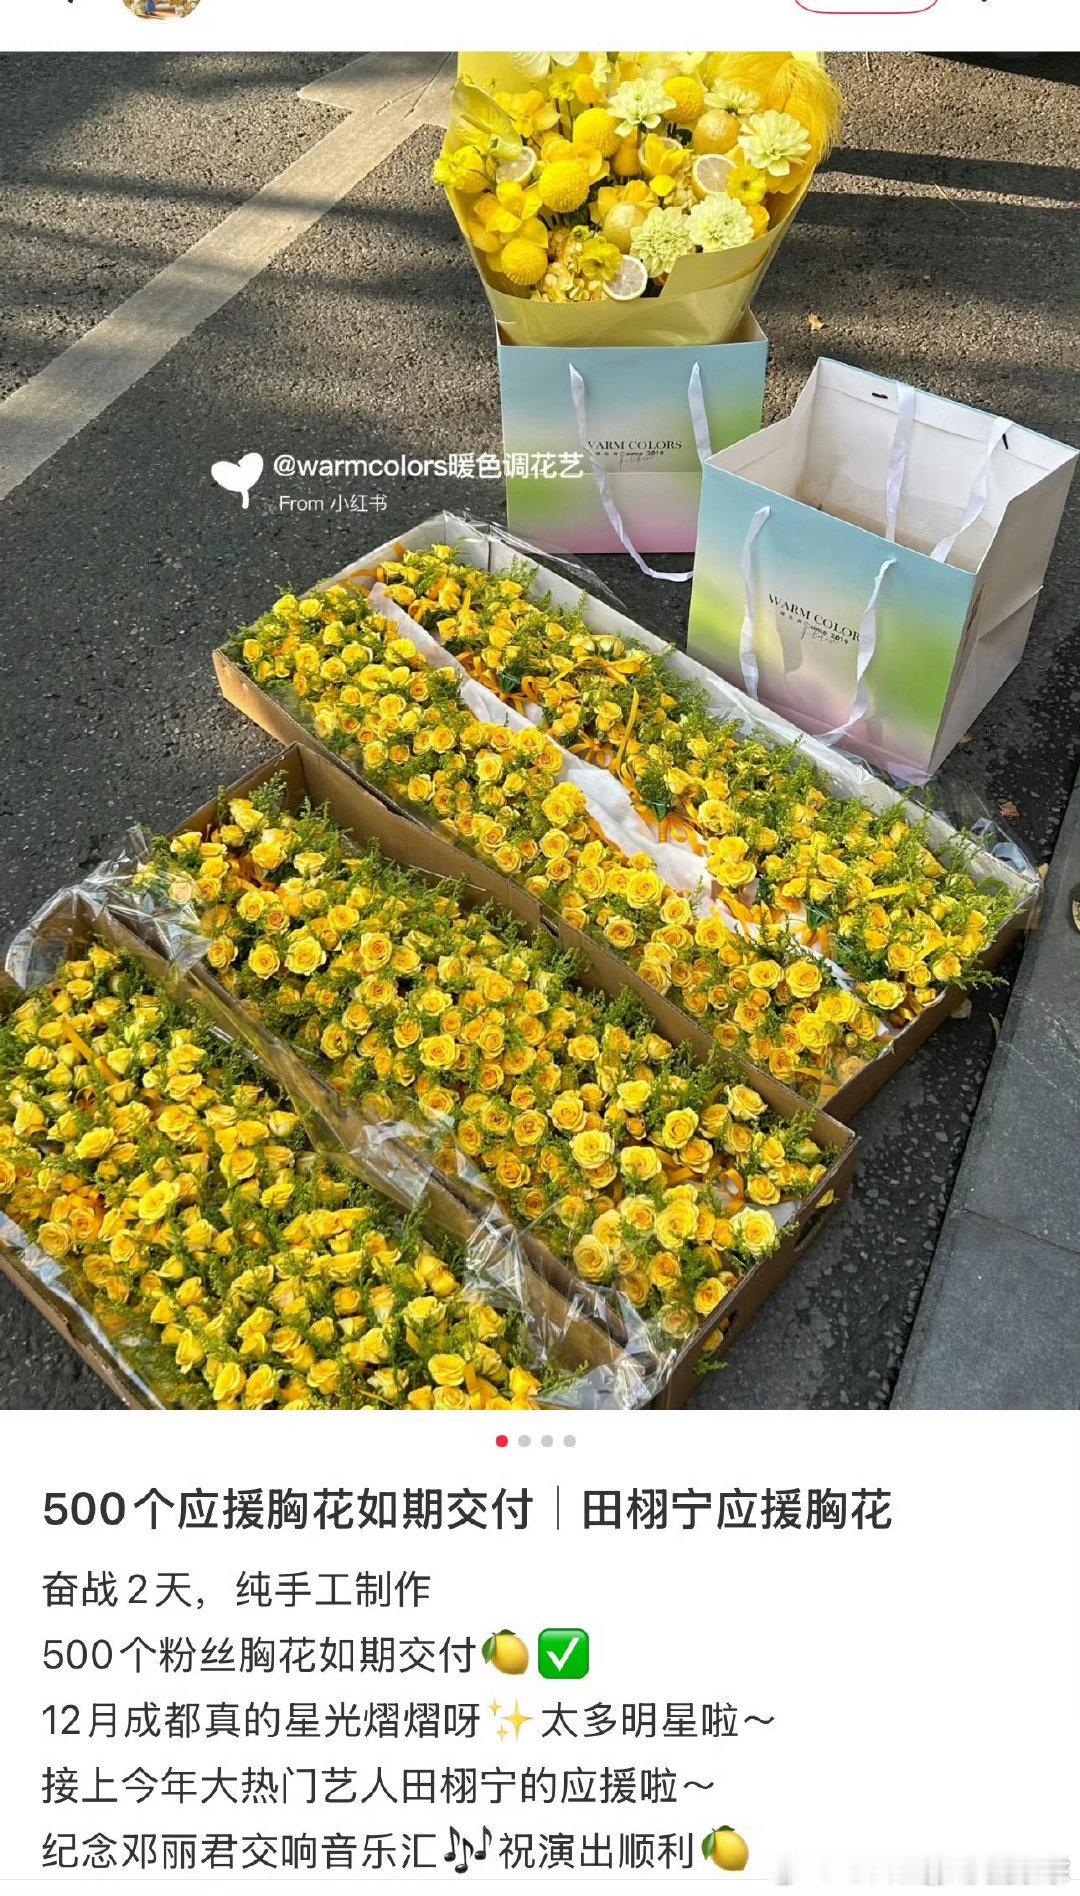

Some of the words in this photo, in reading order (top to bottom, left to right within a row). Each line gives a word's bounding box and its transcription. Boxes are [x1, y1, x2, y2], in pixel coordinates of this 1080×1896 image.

[629, 440, 682, 450] COLORS
[768, 593, 811, 620] WARM
[813, 614, 860, 642] COLOR
